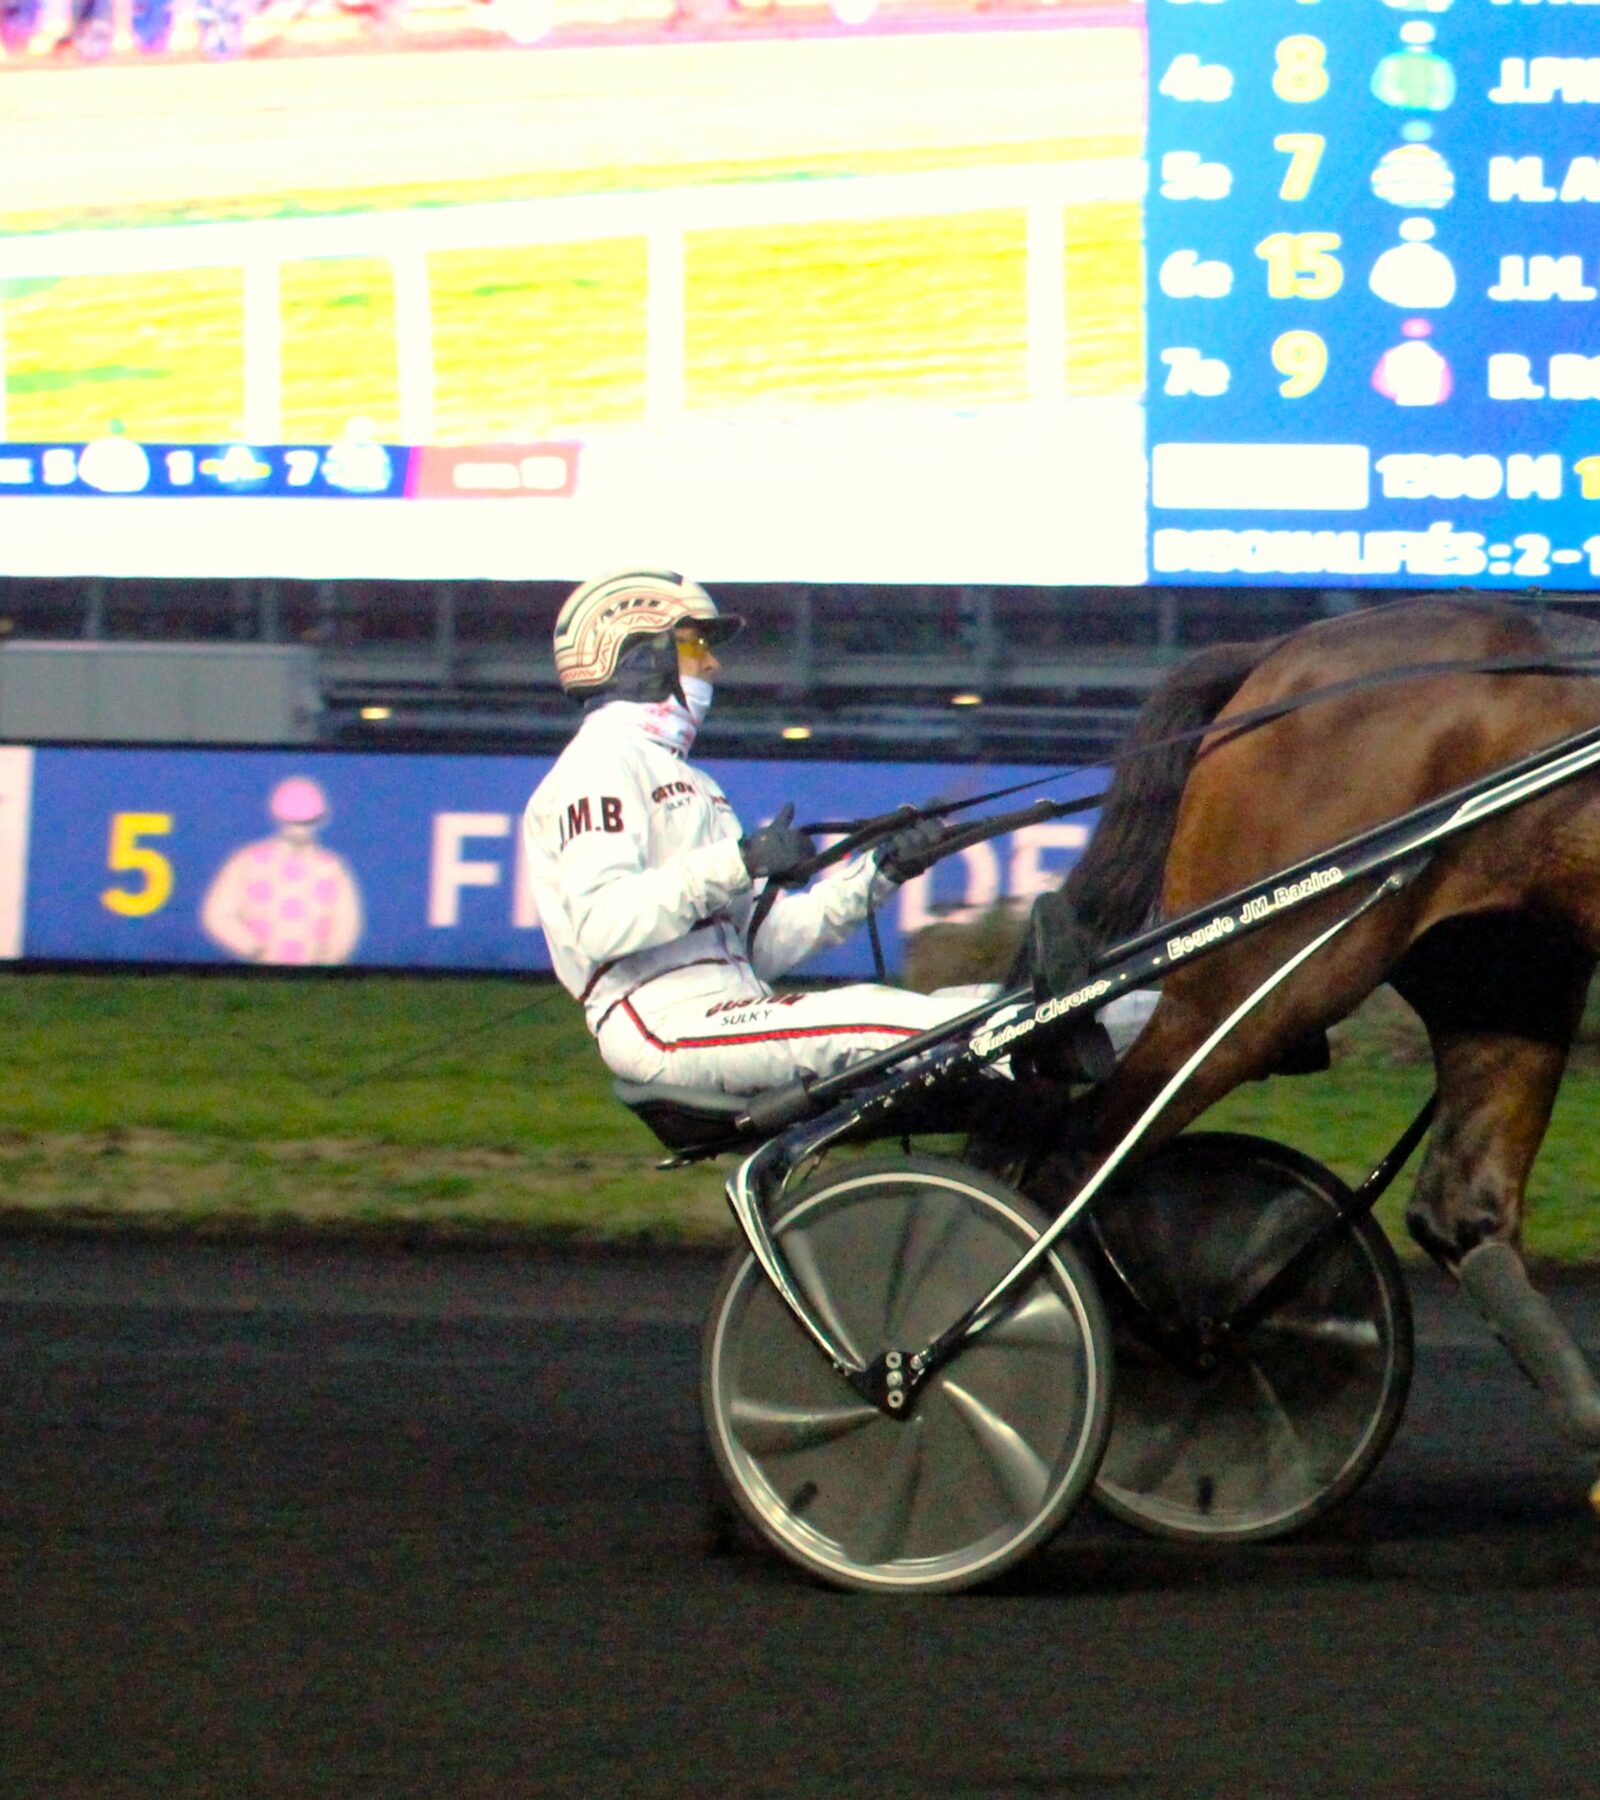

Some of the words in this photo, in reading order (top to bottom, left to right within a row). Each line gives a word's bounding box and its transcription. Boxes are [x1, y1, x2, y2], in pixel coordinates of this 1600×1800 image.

[1272, 35, 1329, 103] 8
[1273, 133, 1326, 201] 7
[1255, 232, 1344, 300] 15
[1271, 330, 1328, 398] 9
[102, 812, 174, 916] 5
[720, 1009, 773, 1026] SULKY
[1035, 979, 1112, 1023] Chrono
